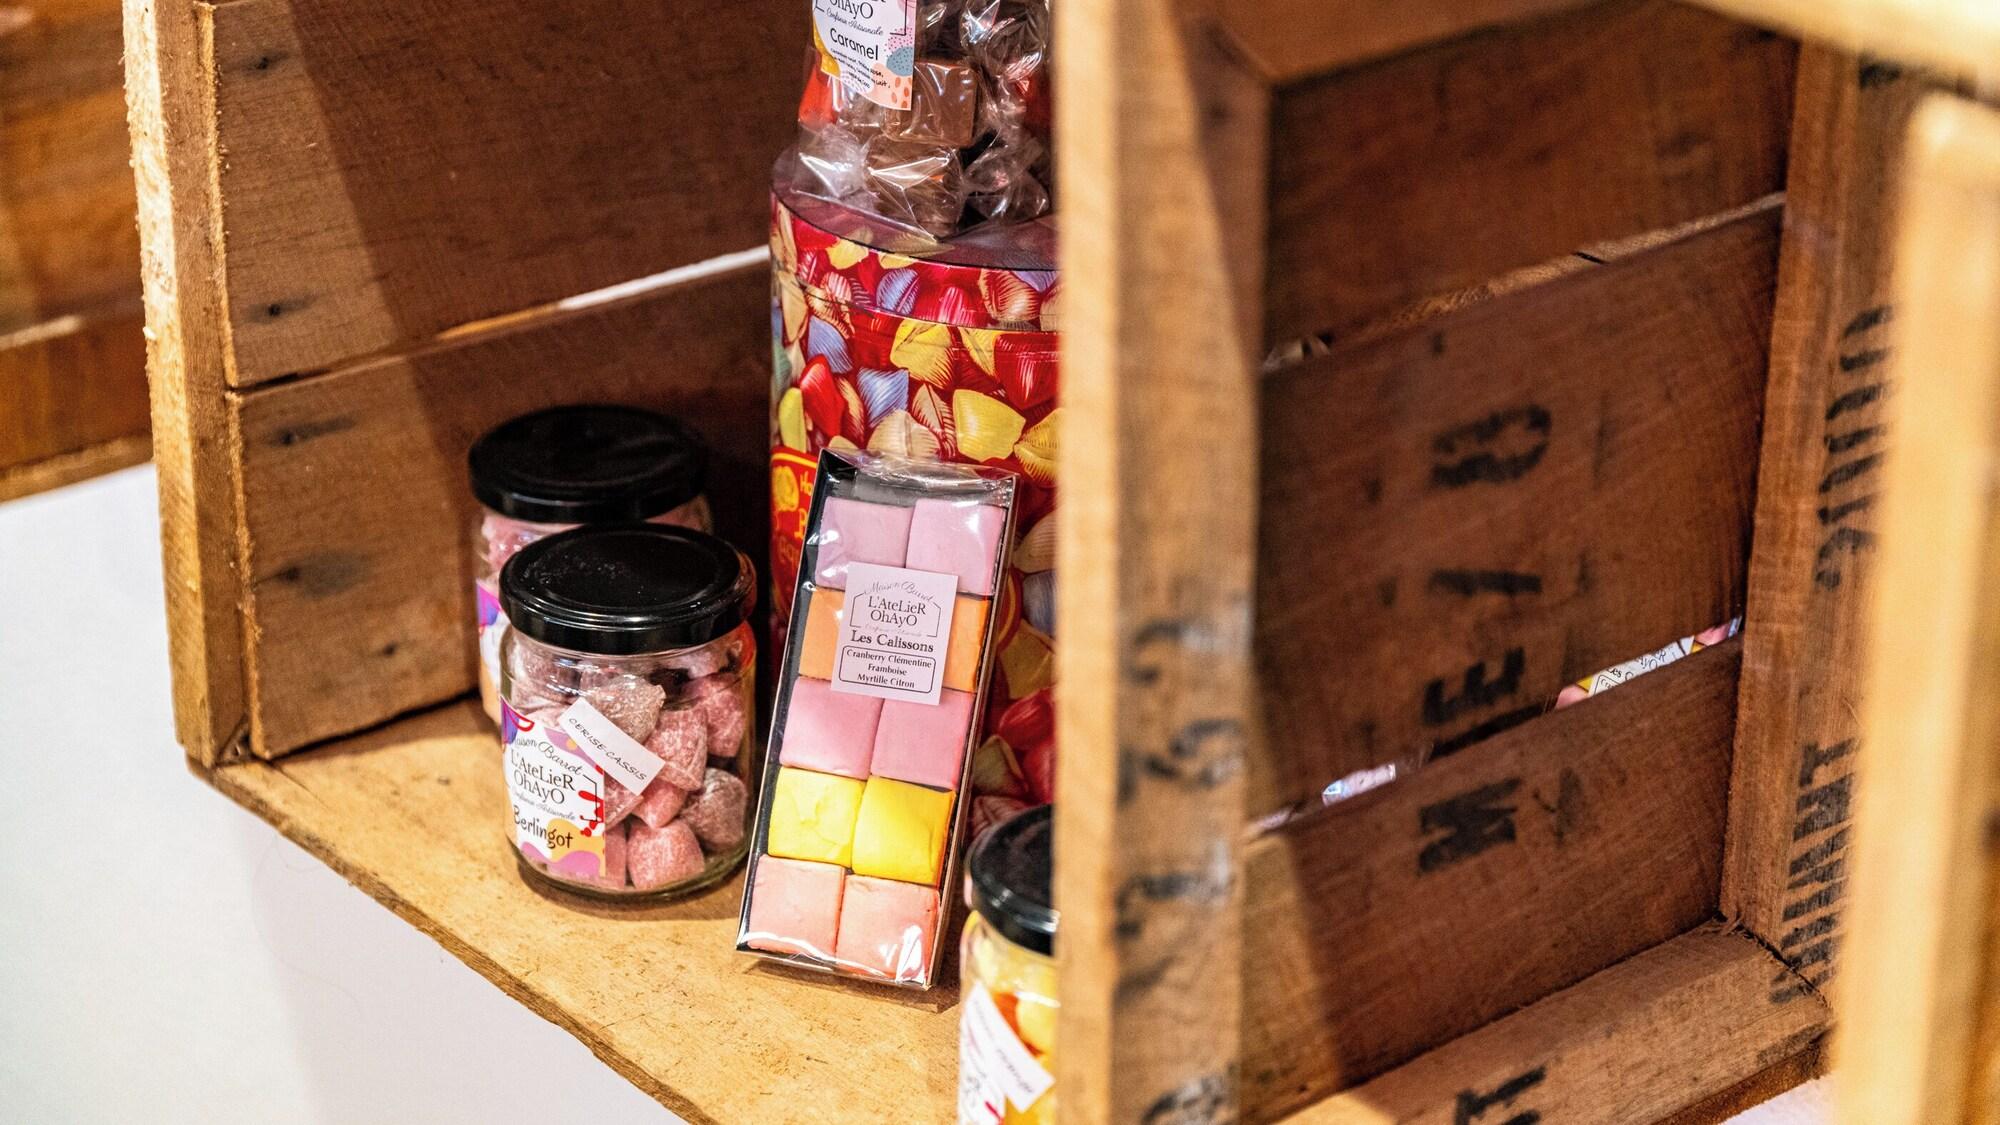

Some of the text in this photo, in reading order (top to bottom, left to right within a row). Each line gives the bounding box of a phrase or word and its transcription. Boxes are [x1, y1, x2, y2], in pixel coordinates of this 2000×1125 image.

[829, 27, 880, 61] Caramel
[868, 595, 927, 616] L'AteLieR
[870, 609, 918, 628] OhAyO
[850, 630, 872, 645] Les
[876, 633, 935, 653] Calissons
[846, 649, 933, 669] Cranberry Clémentine
[867, 663, 908, 676] Framboise
[857, 673, 915, 689] Myrtille Citron
[568, 717, 648, 782] CERISE-CASSIS
[510, 748, 576, 791] L'AteLieR
[513, 770, 565, 805] OhAyO
[513, 805, 574, 849] Berlingot
